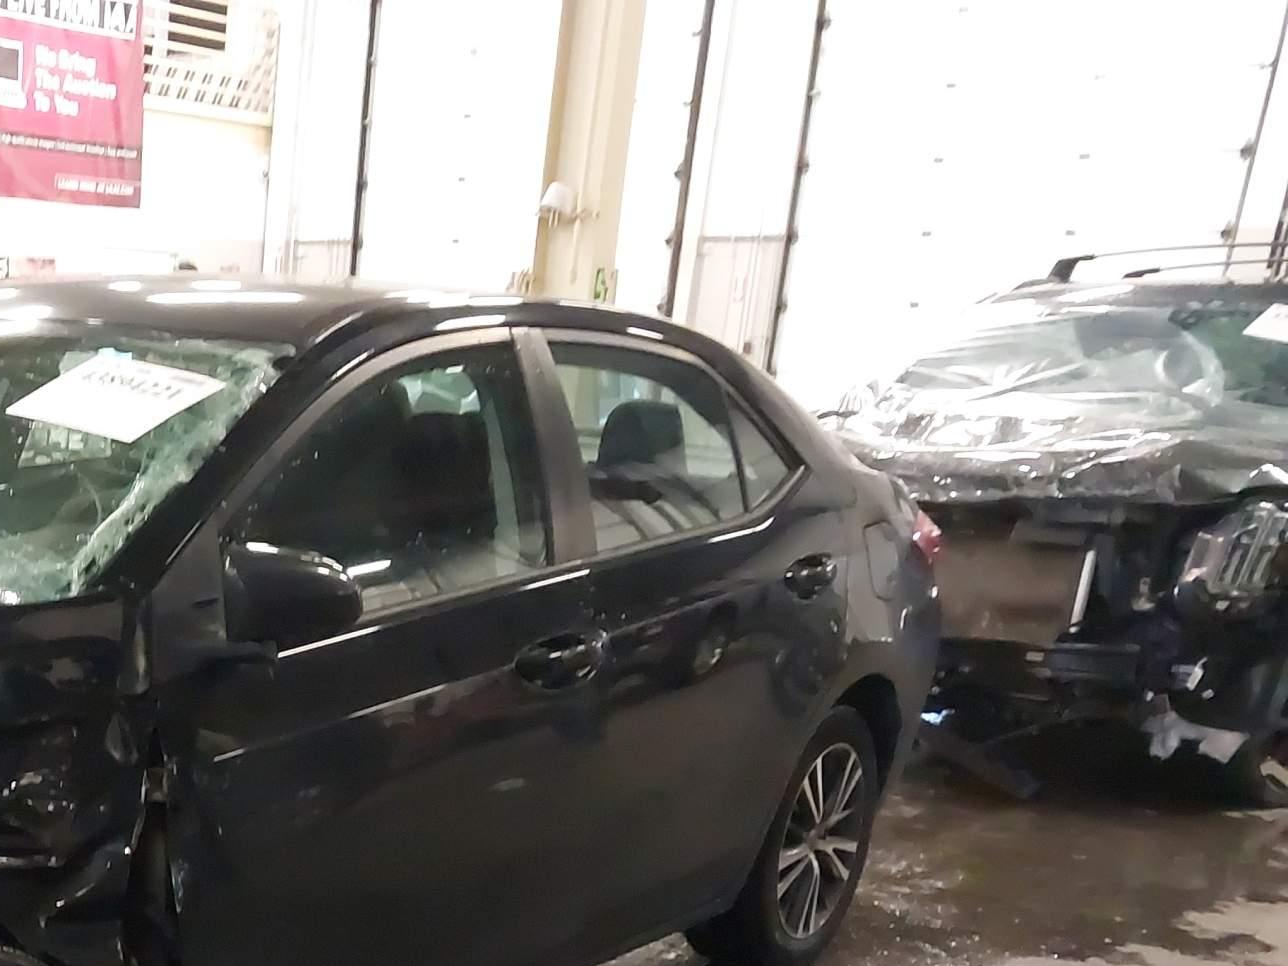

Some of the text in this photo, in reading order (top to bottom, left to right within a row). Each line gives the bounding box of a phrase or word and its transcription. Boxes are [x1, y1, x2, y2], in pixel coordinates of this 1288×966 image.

[58, 49, 96, 78] Bring
[35, 67, 116, 100] The Auction
[34, 90, 79, 116] To You
